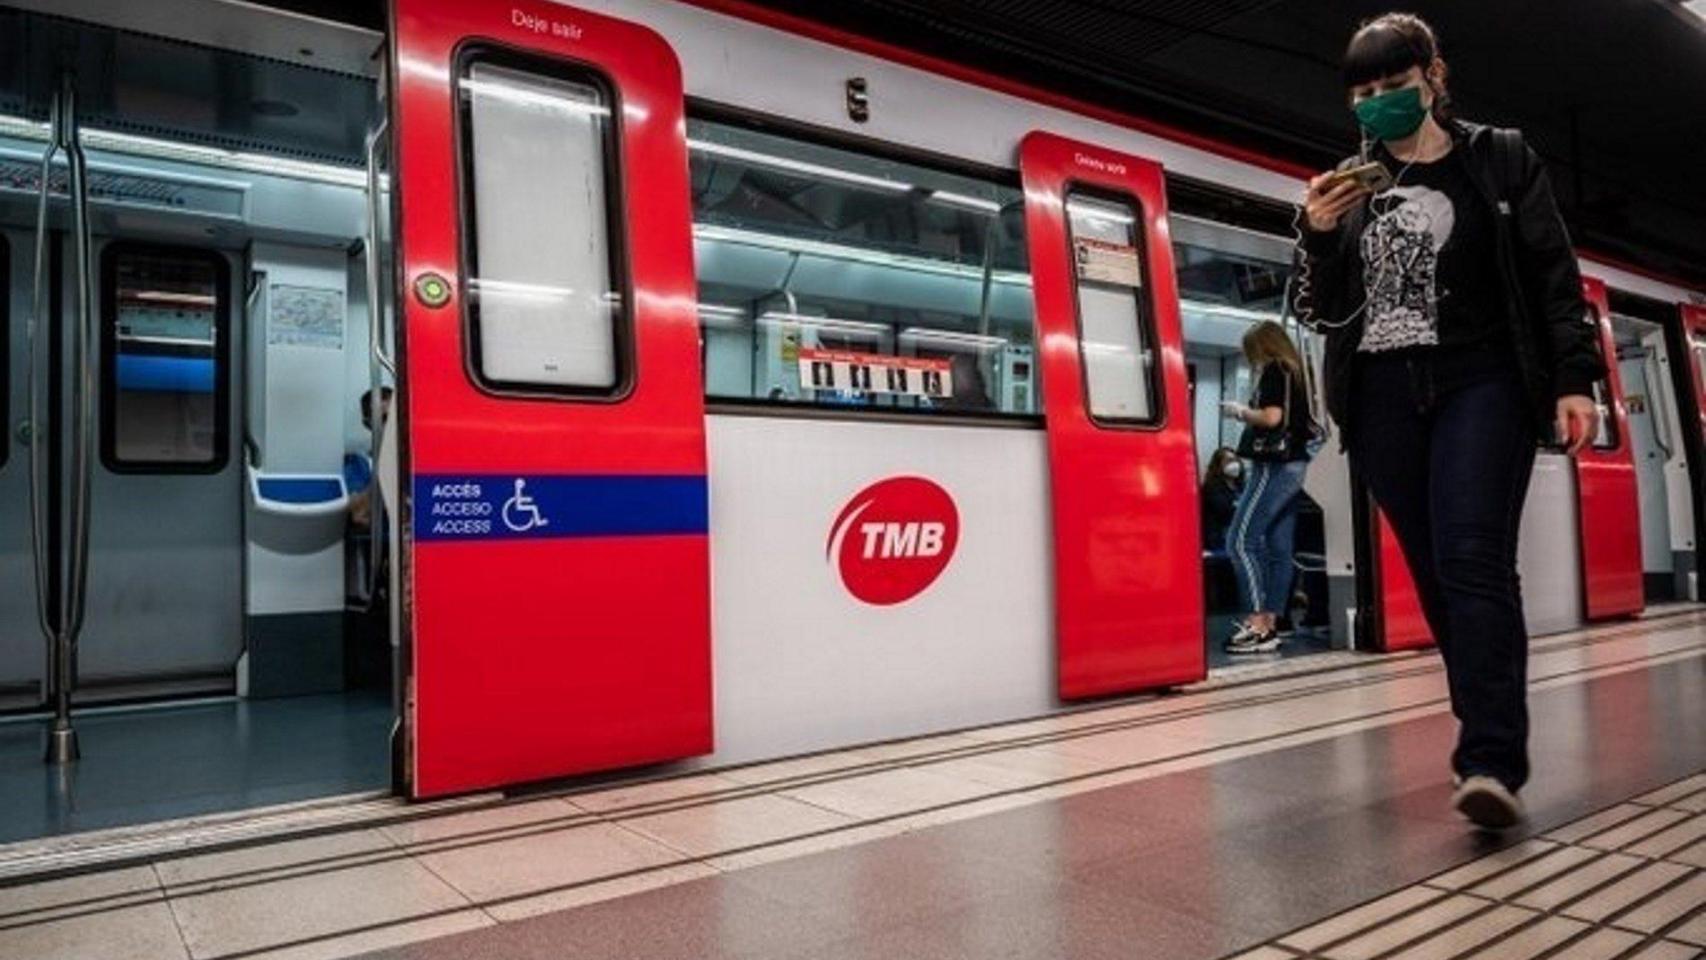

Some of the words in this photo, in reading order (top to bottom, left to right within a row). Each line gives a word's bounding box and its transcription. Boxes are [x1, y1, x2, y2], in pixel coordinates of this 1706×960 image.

[511, 9, 548, 33] Deje
[432, 502, 492, 516] ACCESO
[432, 519, 491, 534] ACCESS
[861, 521, 945, 559] TMB
